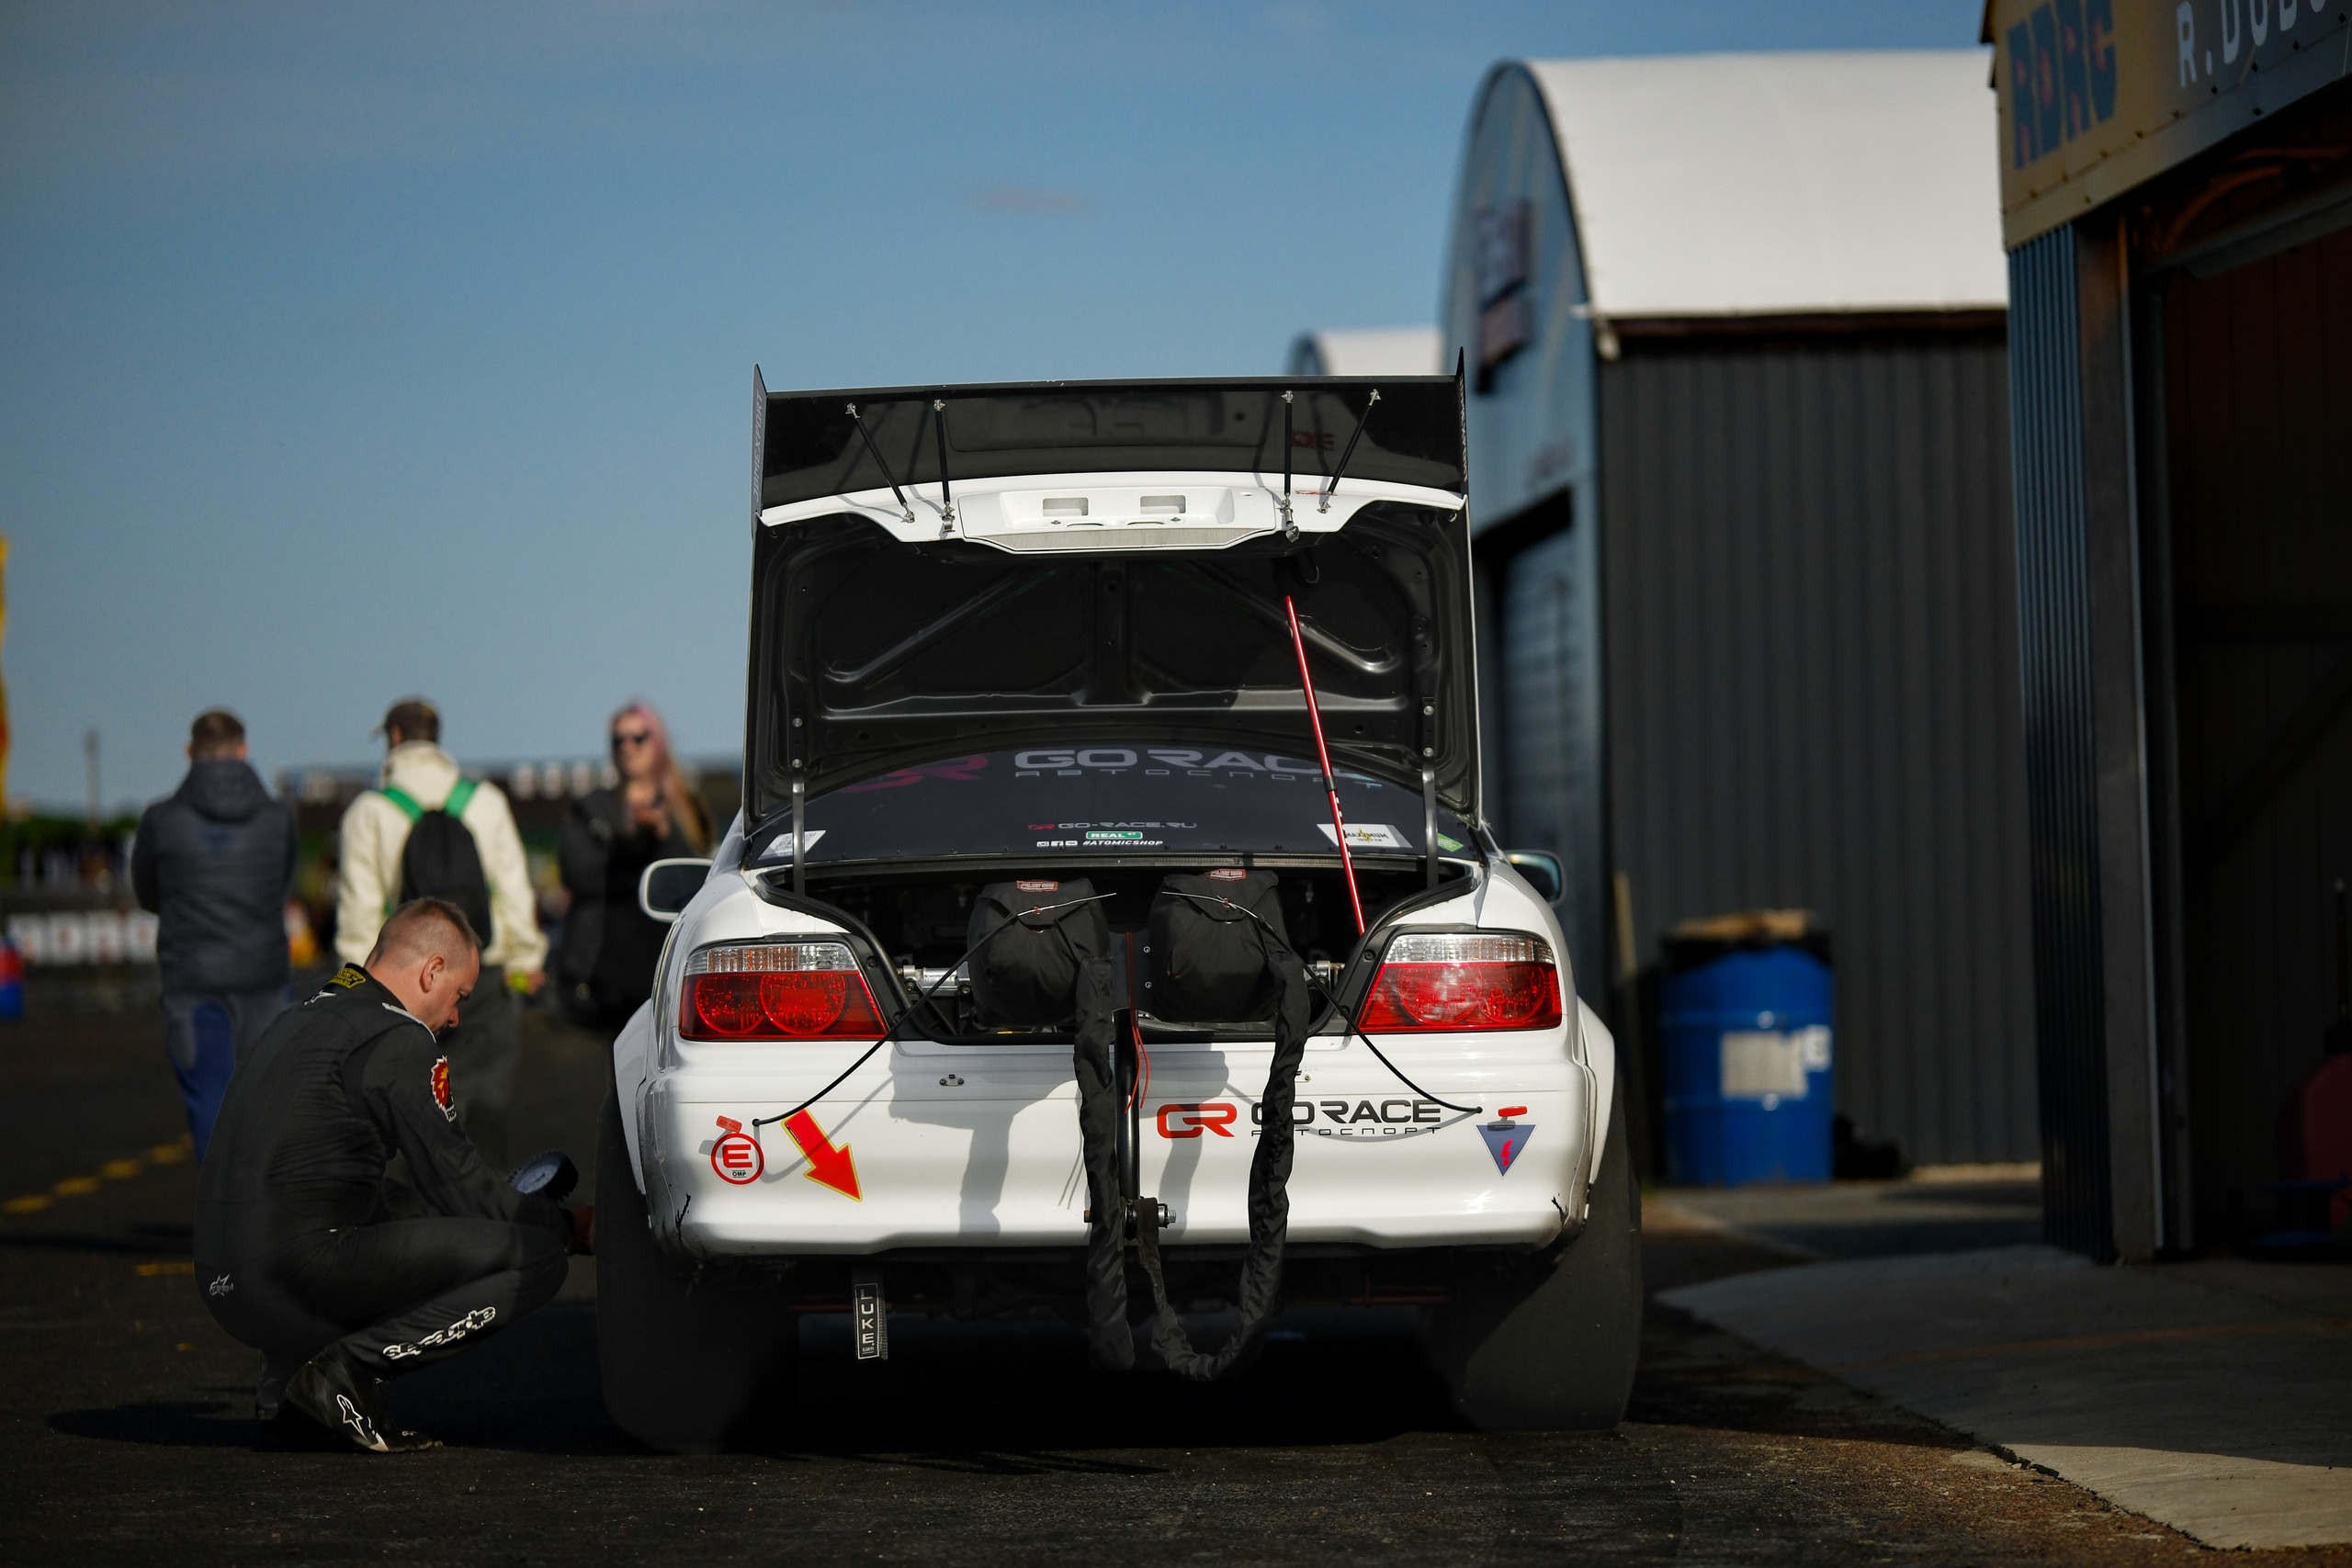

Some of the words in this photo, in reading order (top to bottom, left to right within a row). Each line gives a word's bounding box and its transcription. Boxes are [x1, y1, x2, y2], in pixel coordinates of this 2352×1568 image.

[753, 389, 763, 502] JDMEXPORT
[1014, 749, 1138, 769] GO
[1157, 1102, 1238, 1139] GR
[1320, 1100, 1441, 1124] RACE
[1251, 1126, 1441, 1137] АТОСПОРТ
[860, 1289, 876, 1344] LUKE
